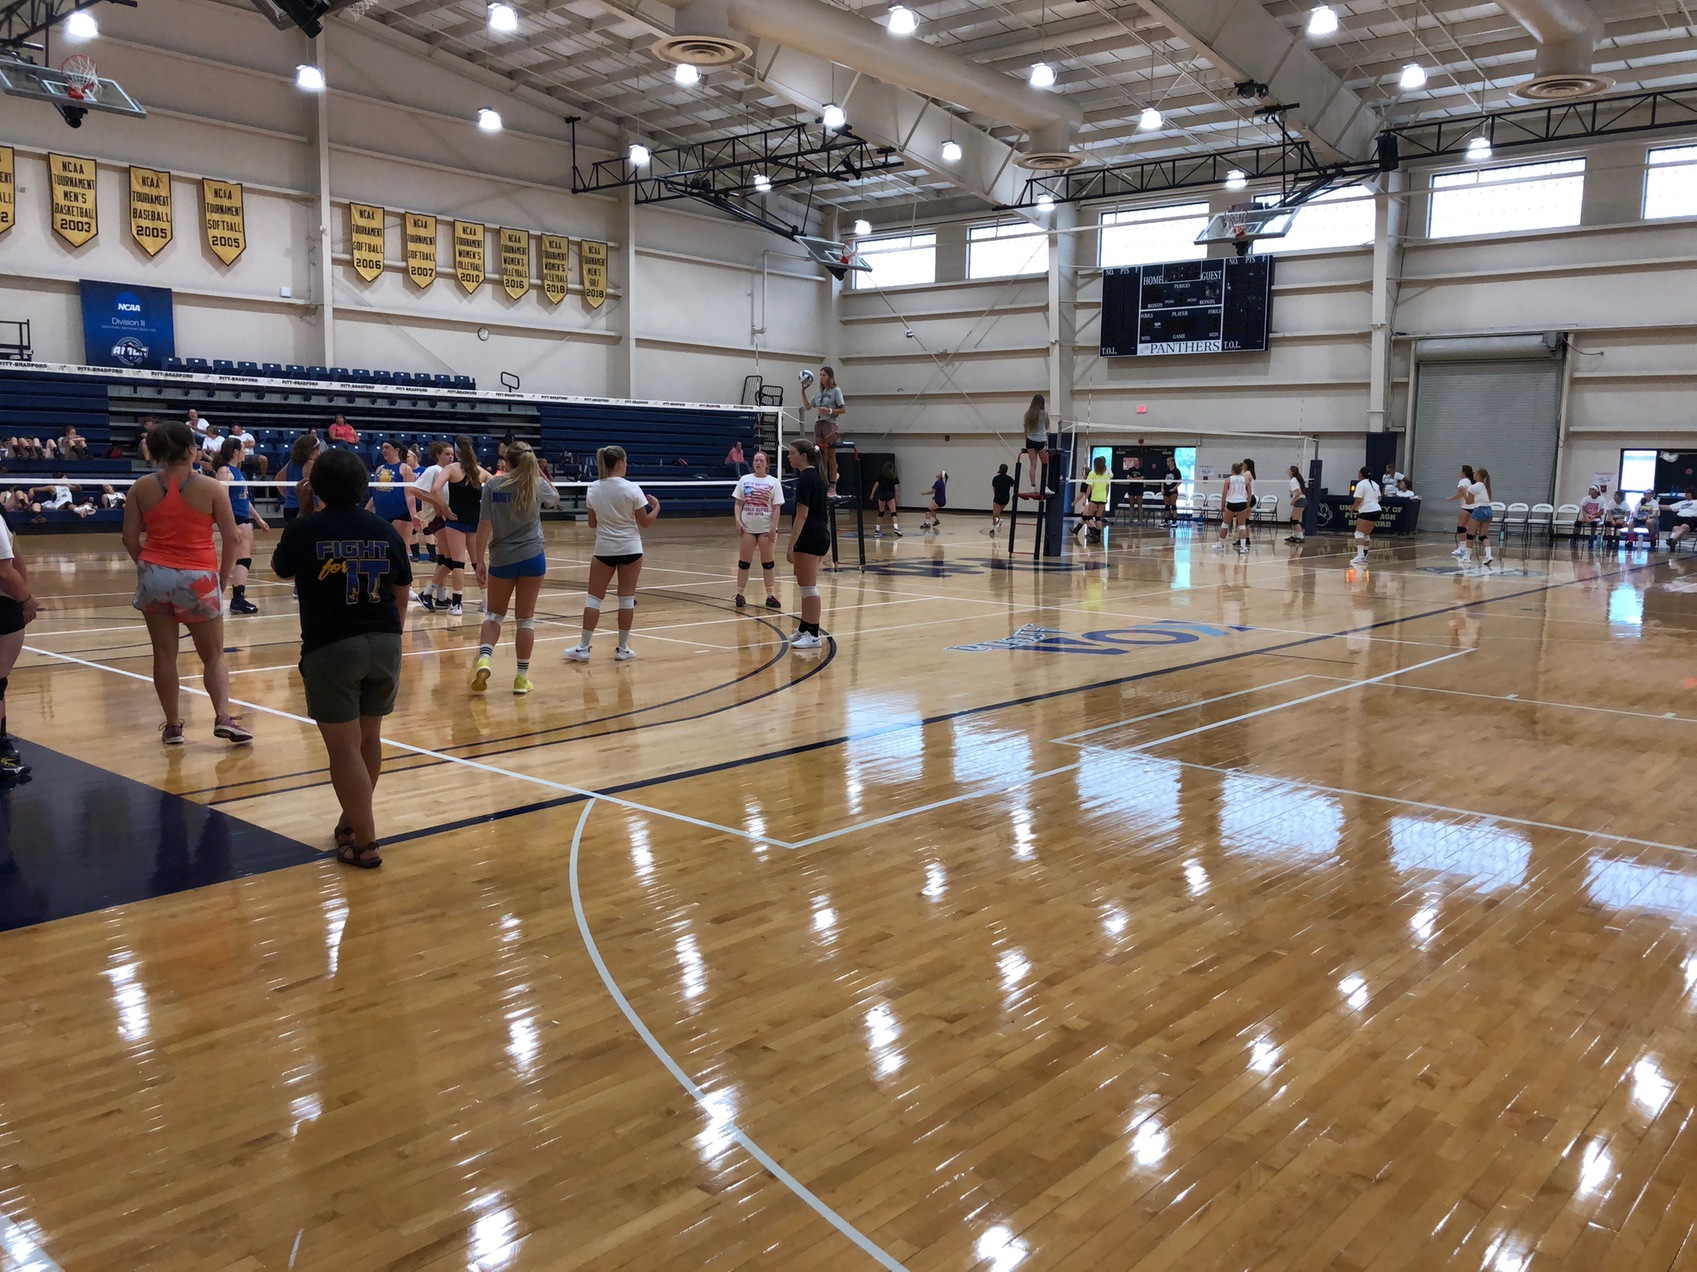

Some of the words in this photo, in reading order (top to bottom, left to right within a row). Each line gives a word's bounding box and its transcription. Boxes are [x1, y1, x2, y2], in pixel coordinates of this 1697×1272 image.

[61, 161, 85, 175] NCAA
[53, 173, 95, 191] TOURNAMENT
[141, 175, 160, 189] NCAA
[63, 190, 87, 204] MEN'S
[132, 190, 169, 207] TOURNAMENT
[213, 188, 233, 200] NCAA
[54, 202, 95, 220] BASKETBALL
[132, 207, 171, 223] BASEBALL
[206, 202, 241, 217] TOURNAMENT
[359, 209, 376, 221] NCAA
[60, 218, 91, 233] 2003
[207, 218, 242, 233] SOFTBALL
[352, 223, 383, 238] TOURNAMENT
[412, 218, 428, 230] NCAA
[136, 225, 168, 239] 2005
[462, 225, 477, 237] NCAA
[211, 235, 241, 248] 2005
[407, 233, 436, 246] TOURNAMENT
[456, 236, 483, 249] TOURNAMENT
[352, 240, 384, 254] SOFTBALL
[407, 249, 436, 262] SOFTBALL
[355, 257, 382, 270] 2006
[410, 265, 435, 278] 2007
[460, 272, 481, 284] 2010
[1201, 270, 1222, 281] GUEST
[1143, 274, 1163, 287] HOME
[117, 302, 141, 312] NCAA
[111, 317, 139, 327] Division
[1150, 340, 1220, 354] PANTHERS
[77, 366, 124, 374] PITT-BRADFORD
[316, 540, 389, 560] FIGHT
[317, 558, 350, 581] for
[345, 558, 390, 605] IT
